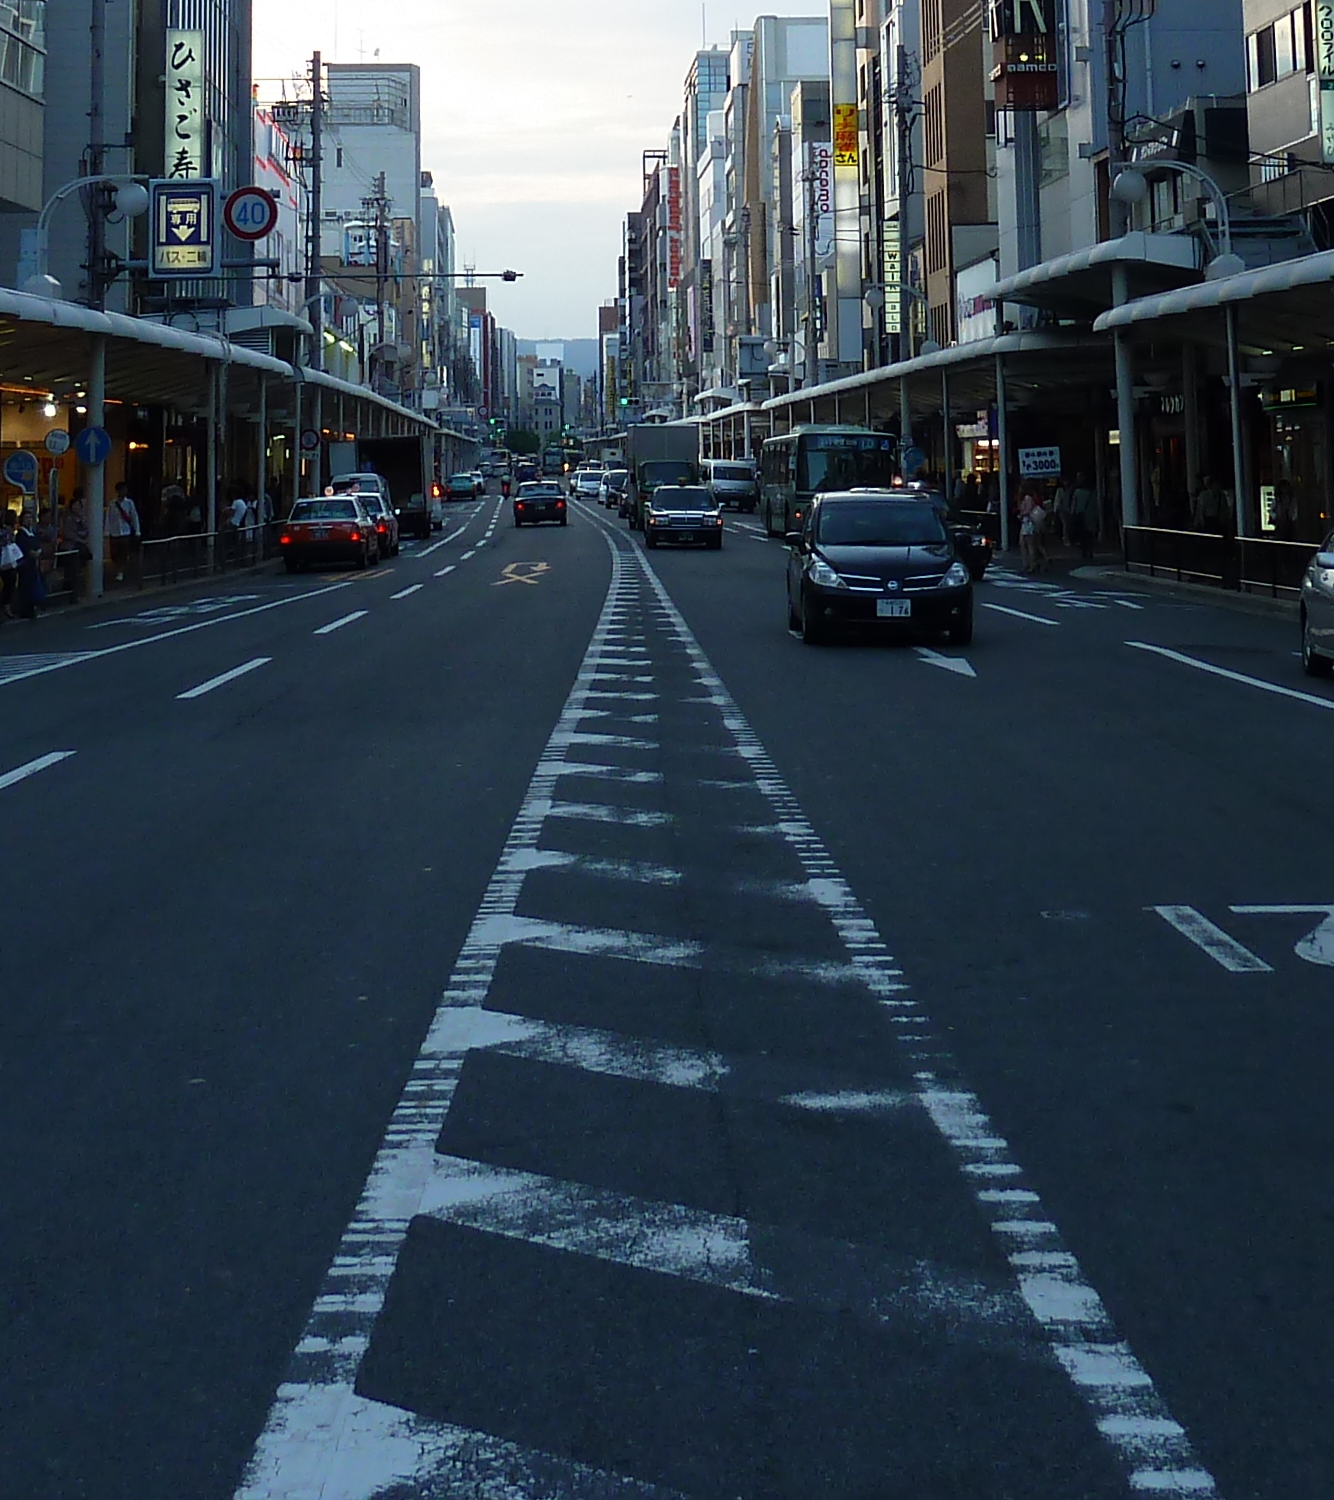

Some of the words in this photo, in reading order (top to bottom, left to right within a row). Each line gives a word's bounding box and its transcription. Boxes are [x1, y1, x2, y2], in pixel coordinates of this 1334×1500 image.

[1007, 62, 1057, 73] namco
[818, 148, 832, 213] docomo
[170, 213, 198, 226] 専用
[236, 202, 265, 227] 40
